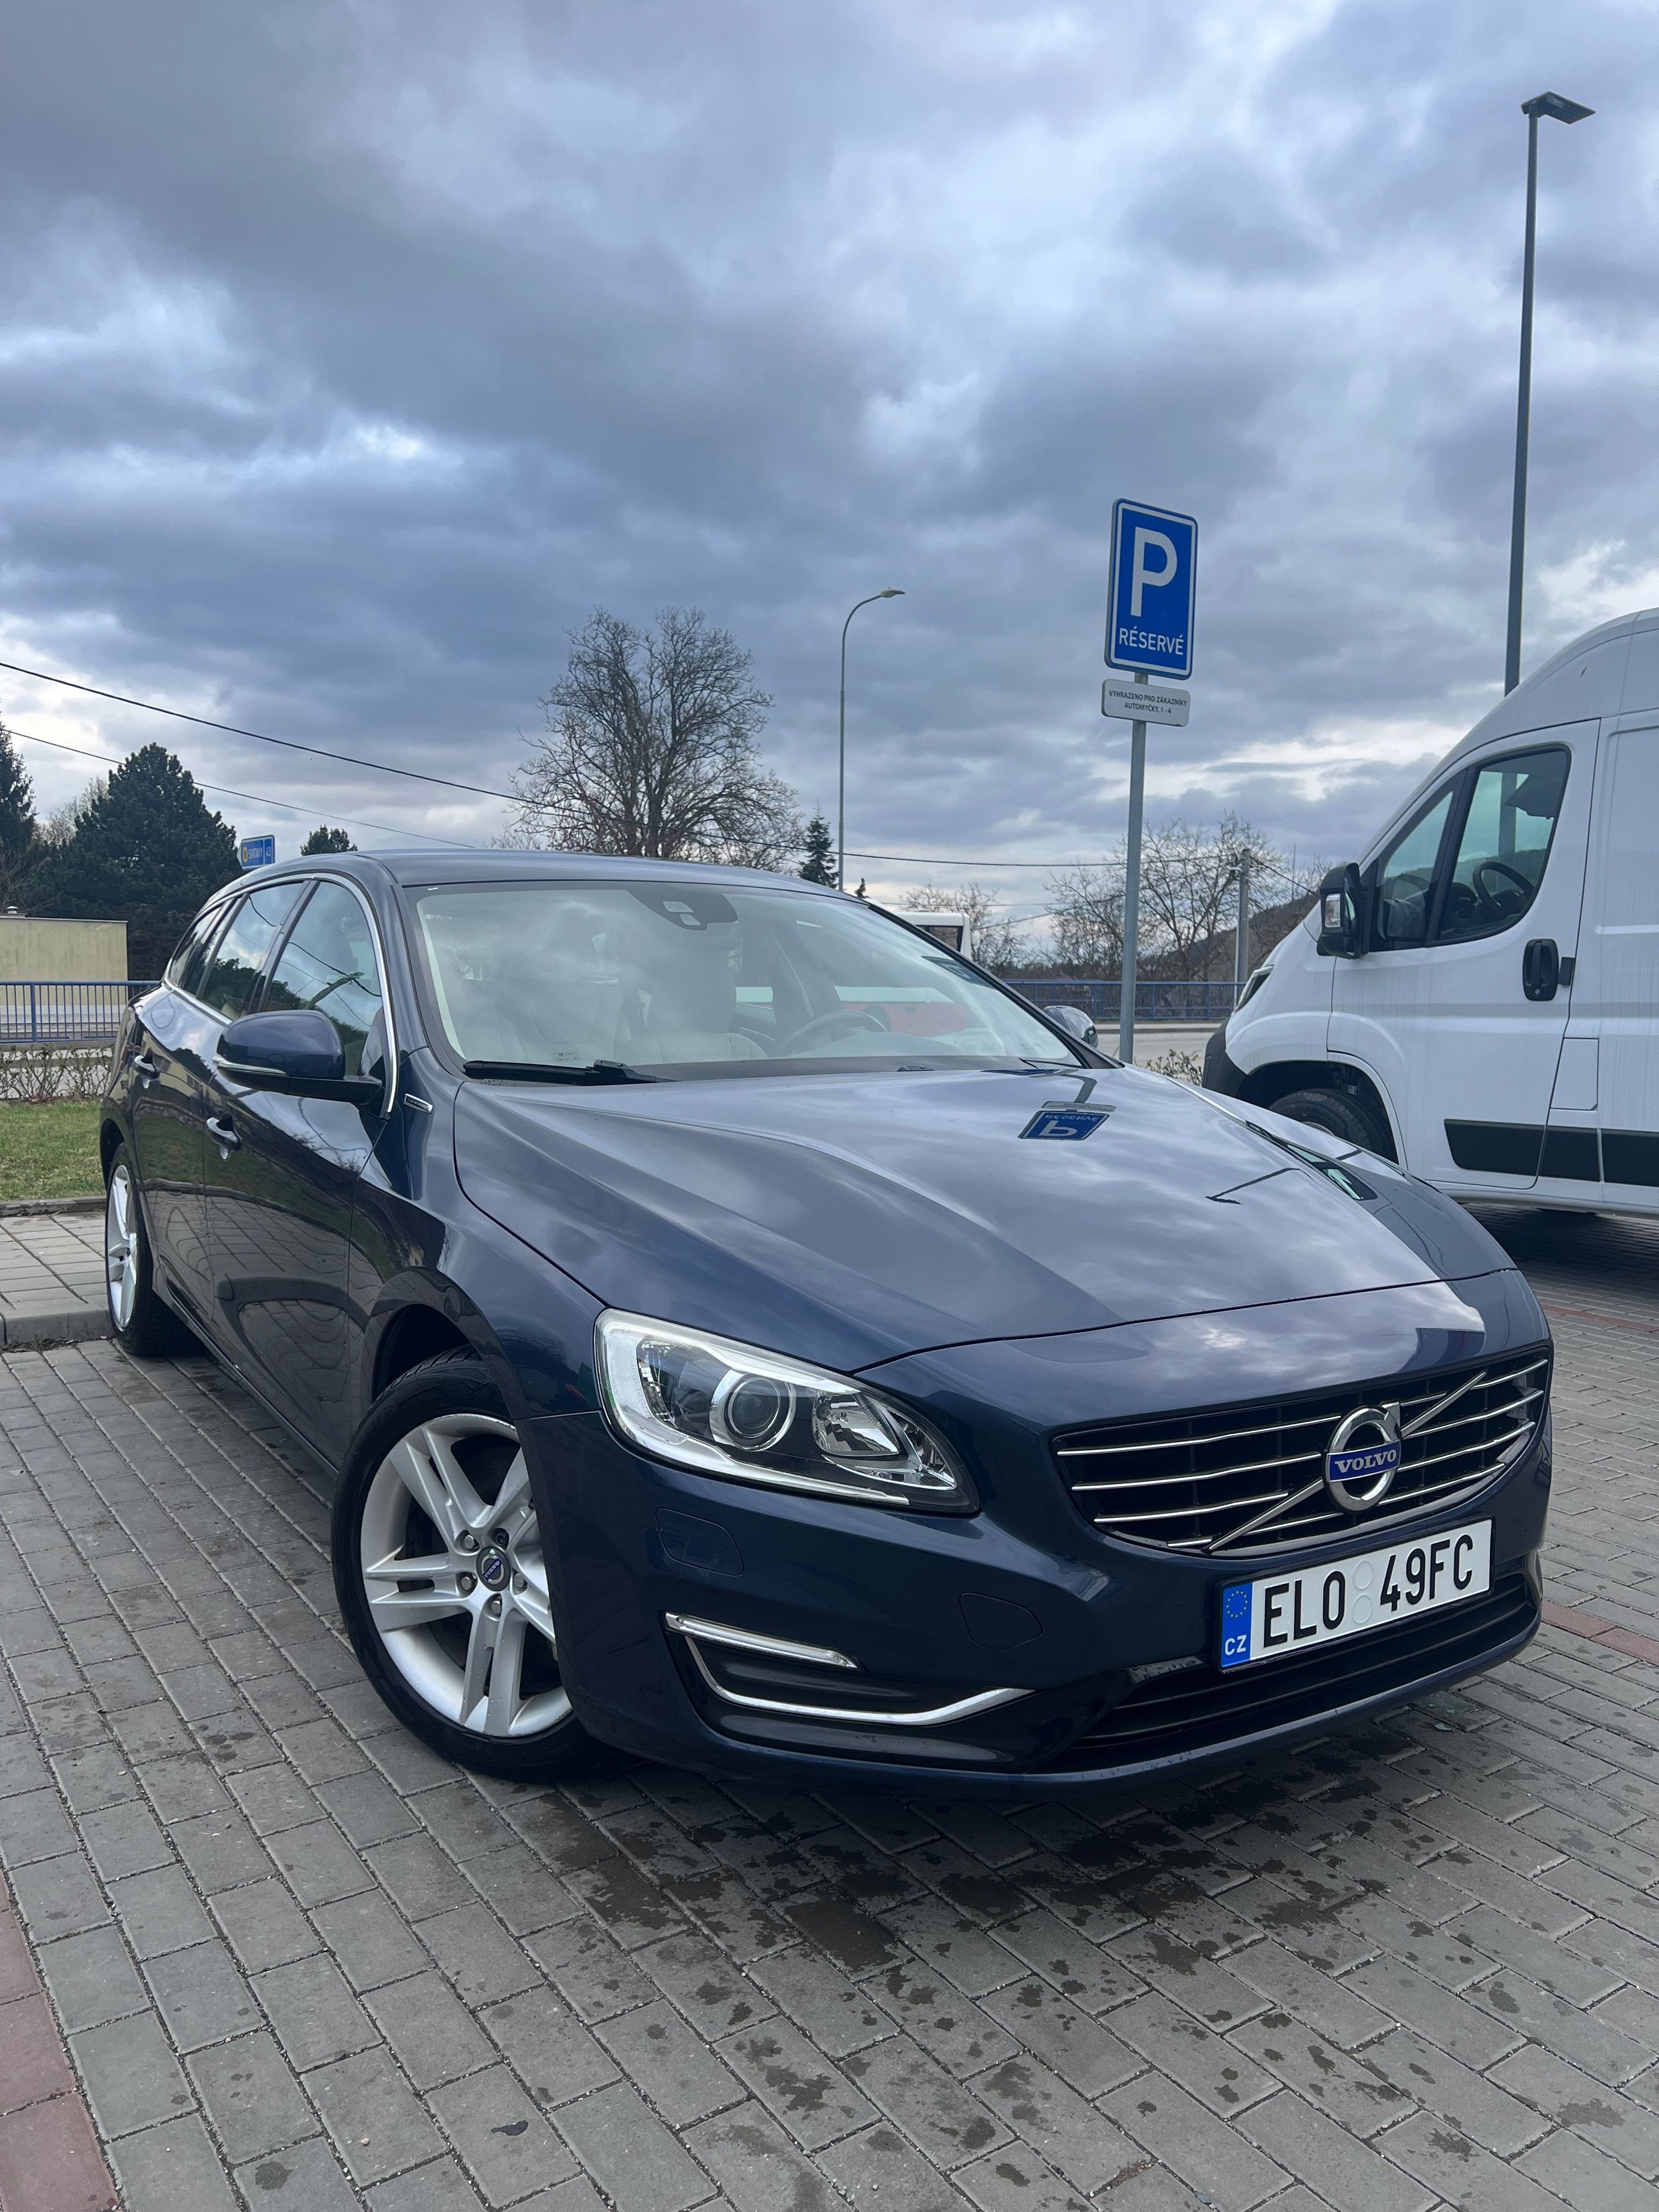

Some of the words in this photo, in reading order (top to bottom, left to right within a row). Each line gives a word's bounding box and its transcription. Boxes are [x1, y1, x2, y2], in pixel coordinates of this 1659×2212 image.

[1130, 526, 1178, 617] P
[1119, 626, 1184, 656] RÉSERVÉ
[1109, 690, 1143, 701] VYHRAZENO
[1156, 695, 1188, 707] ZÁKAZNÍKY
[1334, 1449, 1397, 1474] VOLVO
[483, 1560, 500, 1578] VOLVO
[1380, 1534, 1474, 1612] 49FC
[1224, 1634, 1247, 1656] CZ
